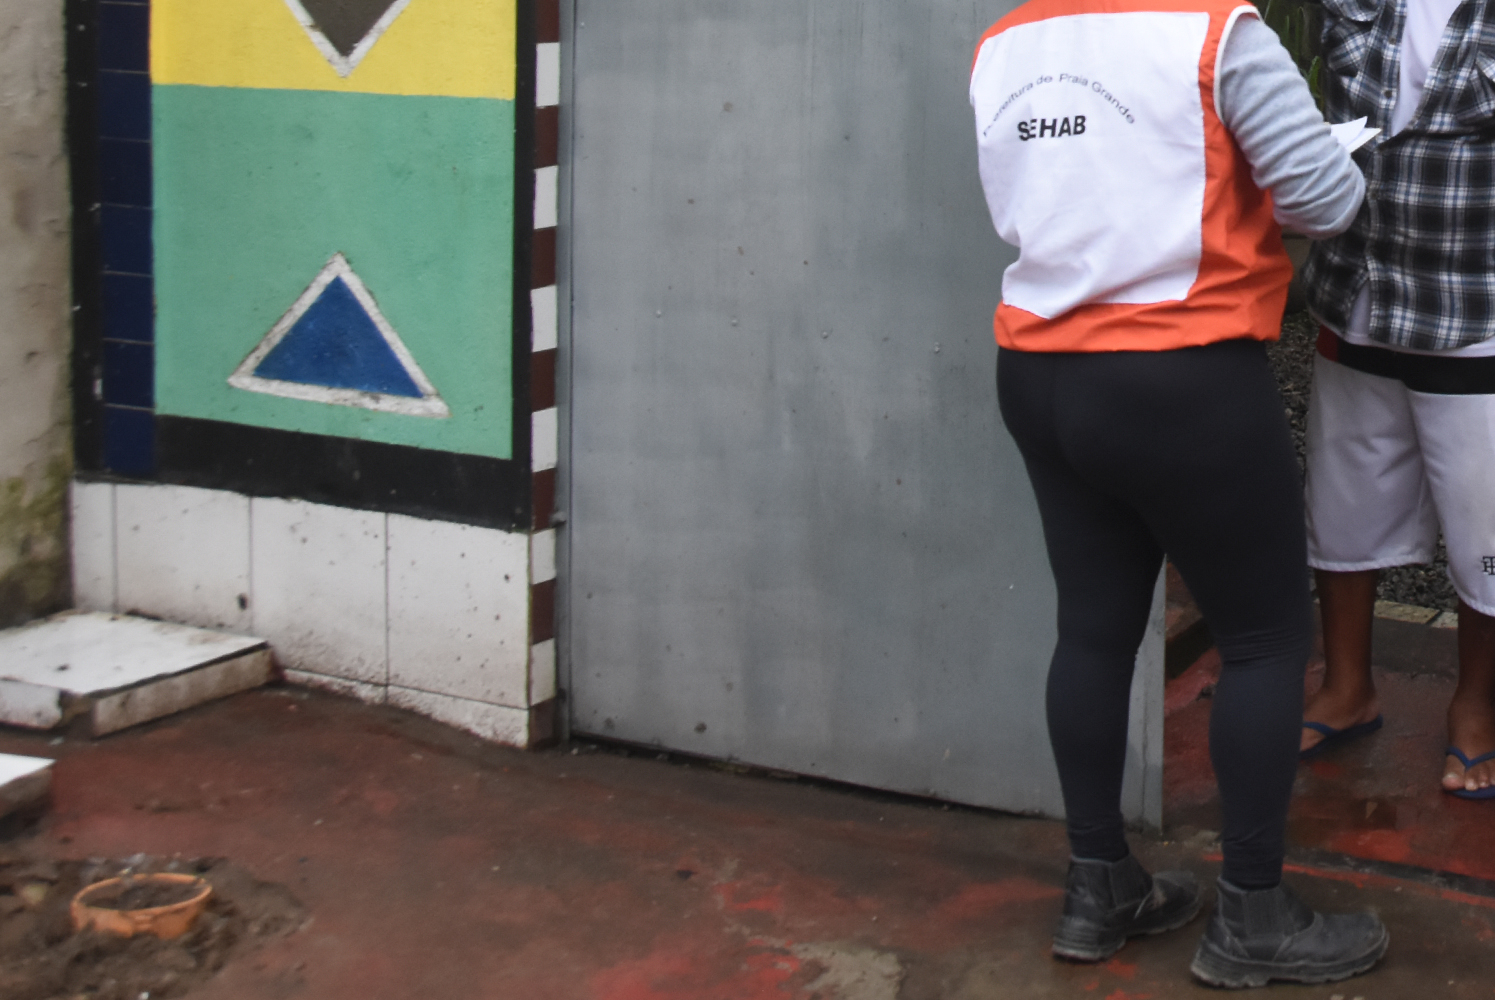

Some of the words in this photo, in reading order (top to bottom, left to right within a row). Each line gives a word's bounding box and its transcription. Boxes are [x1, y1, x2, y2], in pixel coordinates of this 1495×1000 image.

[1036, 74, 1054, 85] de
[1059, 73, 1089, 87] Praia
[1091, 81, 1136, 125] Grande
[1017, 115, 1086, 141] SEHAB
